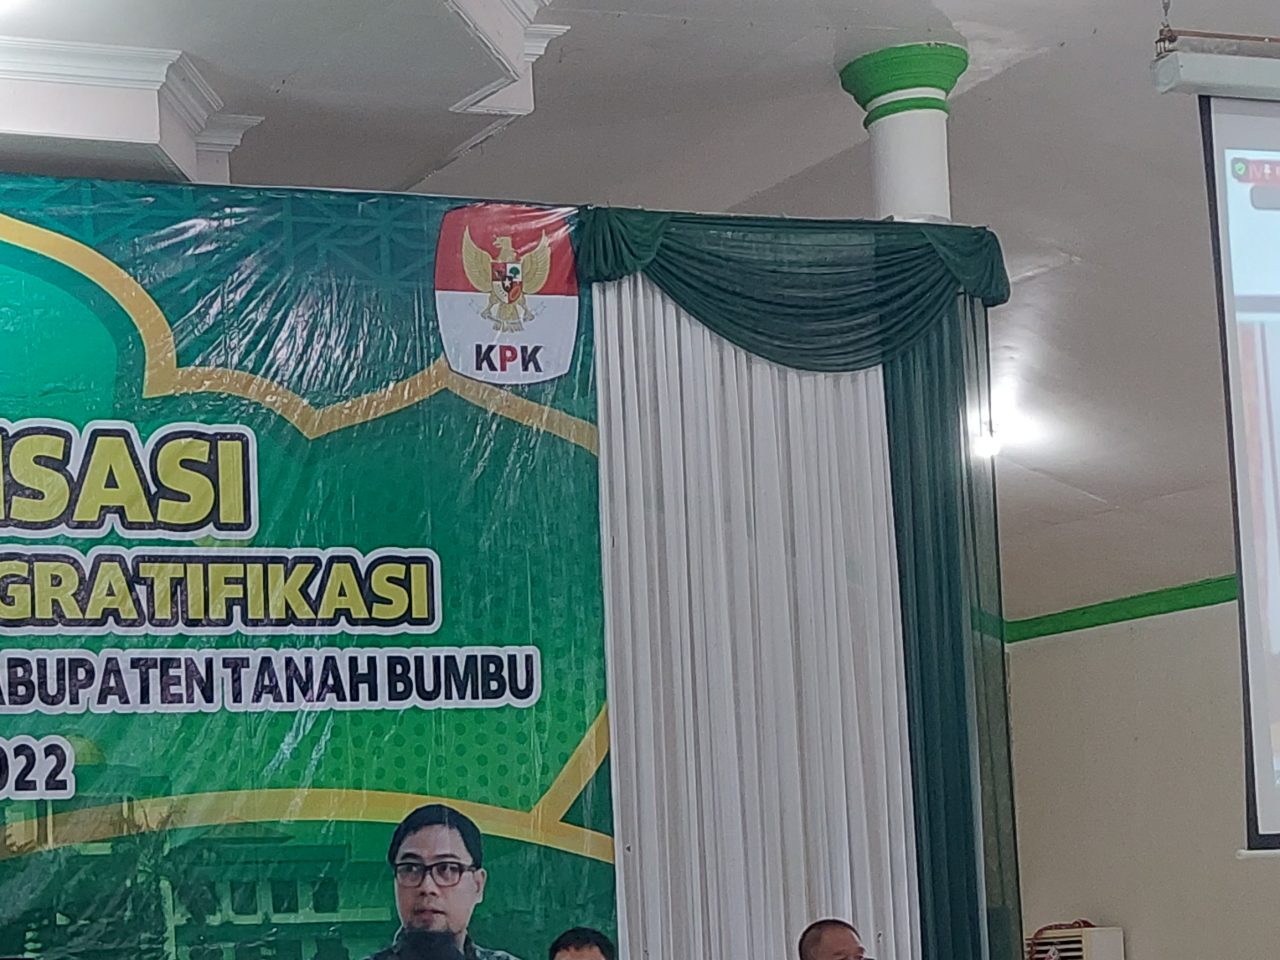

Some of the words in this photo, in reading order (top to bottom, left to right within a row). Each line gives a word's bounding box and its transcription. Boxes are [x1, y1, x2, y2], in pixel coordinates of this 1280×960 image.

[475, 344, 543, 372] KPK
[223, 655, 377, 702] TANAH
[388, 653, 534, 701] BUMBU
